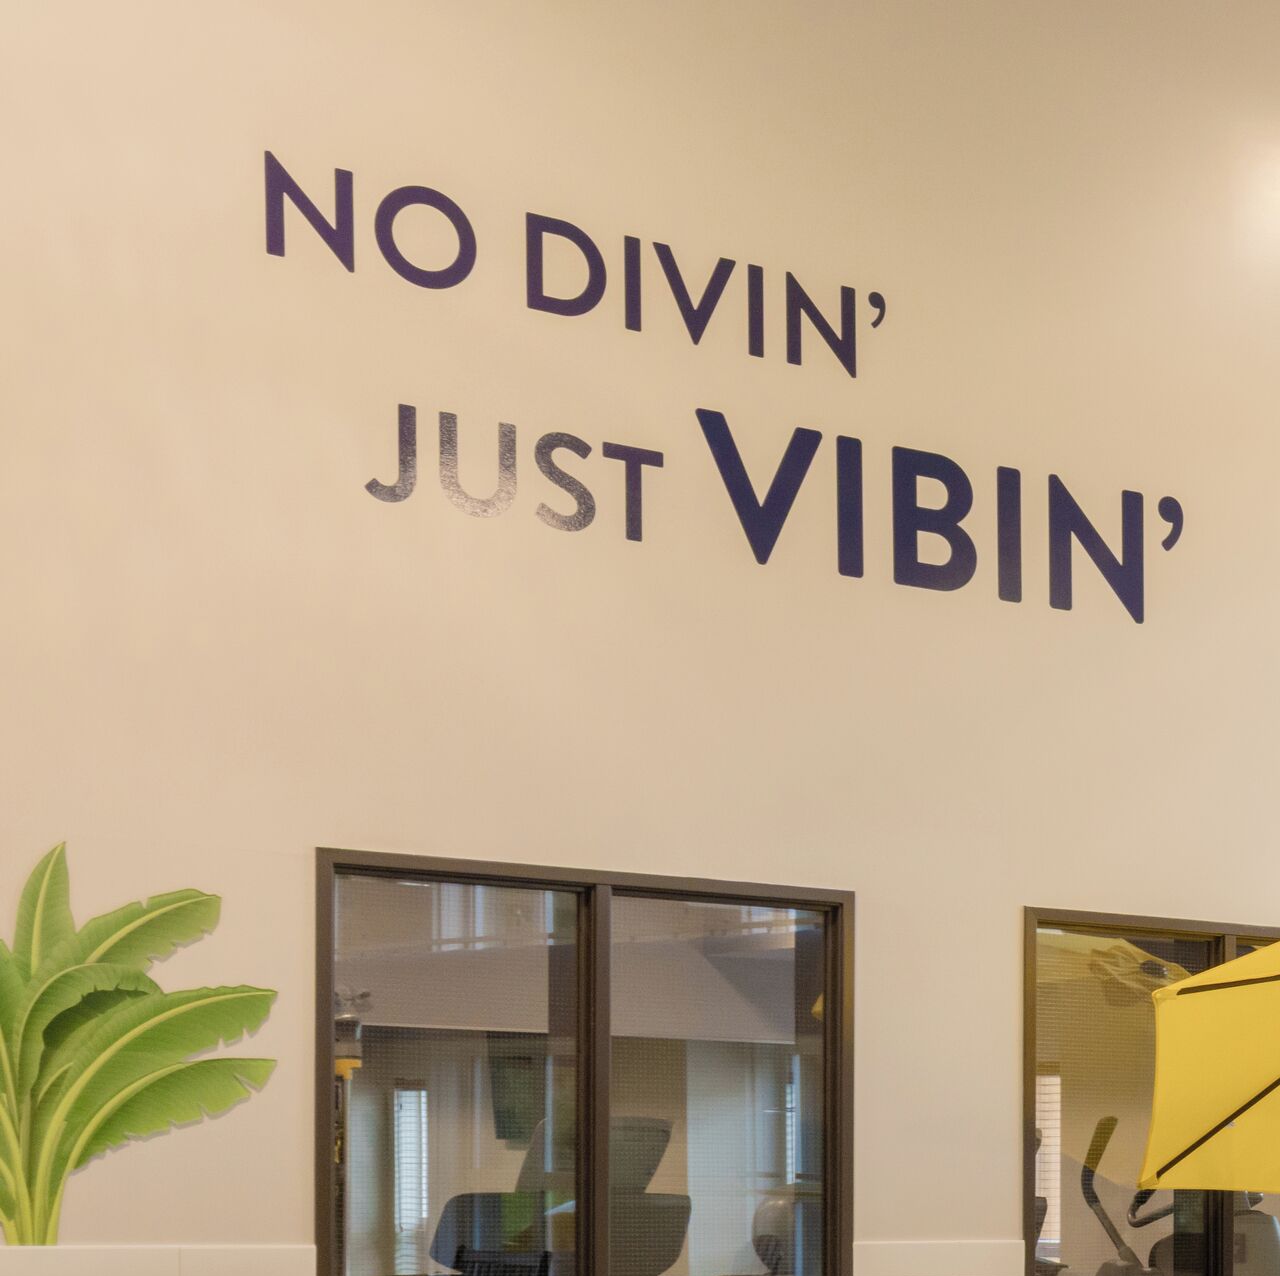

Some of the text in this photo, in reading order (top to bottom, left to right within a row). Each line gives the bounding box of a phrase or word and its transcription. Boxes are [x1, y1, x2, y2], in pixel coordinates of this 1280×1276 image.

[264, 150, 887, 379] NO DIVIN’
[364, 403, 1185, 626] JUST VIBIN’
